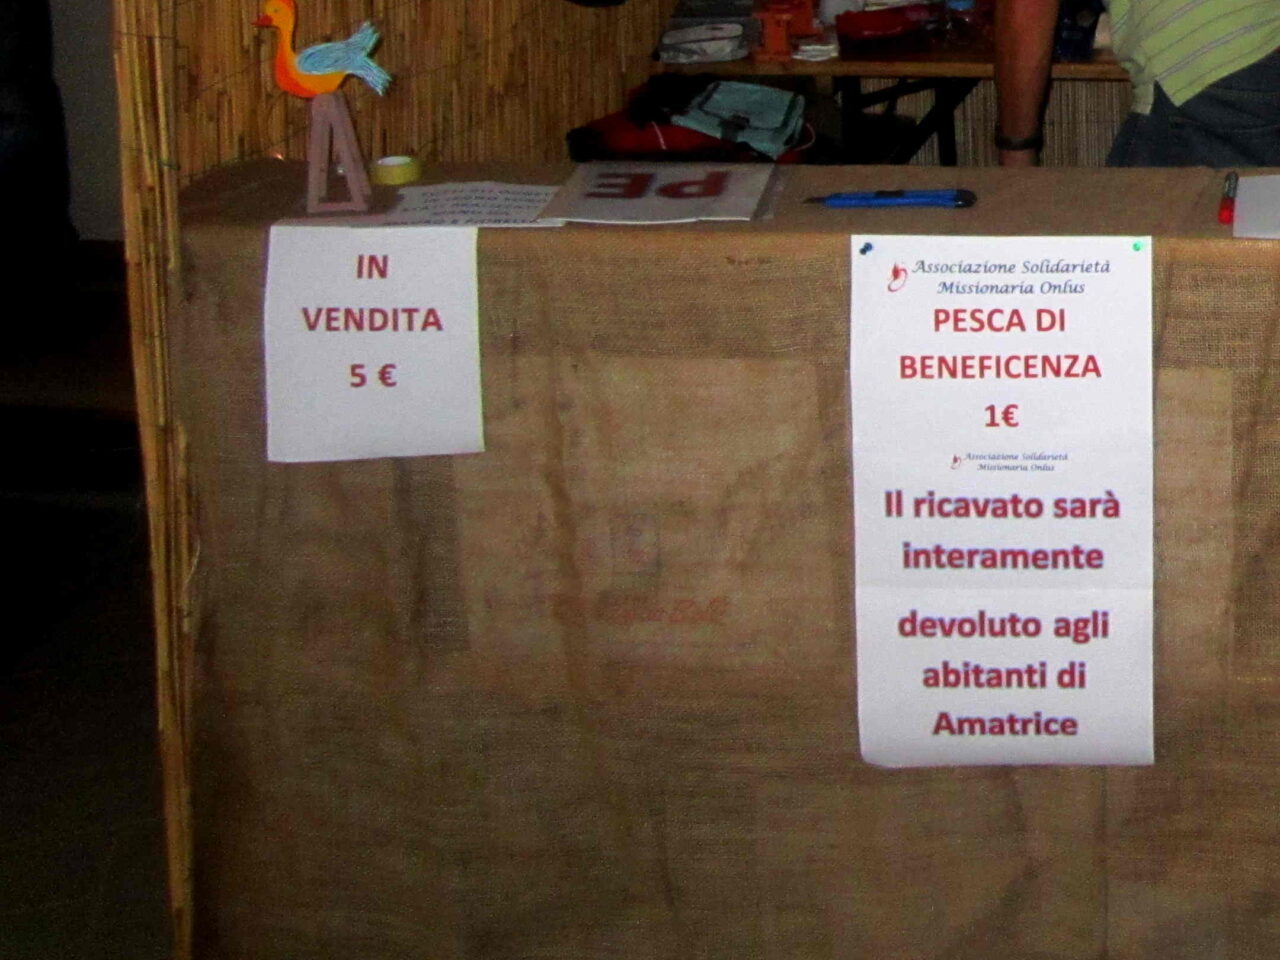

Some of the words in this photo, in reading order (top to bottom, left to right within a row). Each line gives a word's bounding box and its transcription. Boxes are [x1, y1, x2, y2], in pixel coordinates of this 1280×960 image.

[356, 254, 389, 279] IN
[912, 260, 1016, 274] Associazione
[1020, 259, 1111, 274] Solidarietà
[936, 280, 1034, 295] Missionaria
[1039, 281, 1085, 295] Onlus
[301, 307, 443, 332] VENDITA
[933, 308, 1026, 332] PESCA
[1036, 308, 1066, 332] DI
[349, 363, 367, 387] 5
[377, 363, 397, 387] €
[899, 354, 1102, 379] BENEFICENZA
[984, 404, 1020, 428] 1€
[964, 451, 1019, 461] Associazione
[976, 462, 1029, 472] Missionaria
[1030, 463, 1055, 472] Onlus
[885, 490, 903, 518] Il
[913, 490, 1044, 519] ricavato
[1052, 489, 1121, 519] sarà
[902, 541, 1104, 569] interamente
[897, 609, 1042, 638] devoluto
[1053, 610, 1110, 644] agli
[922, 660, 1047, 689] abitanti
[1056, 661, 1087, 689] di
[932, 711, 1078, 736] Amatrice
